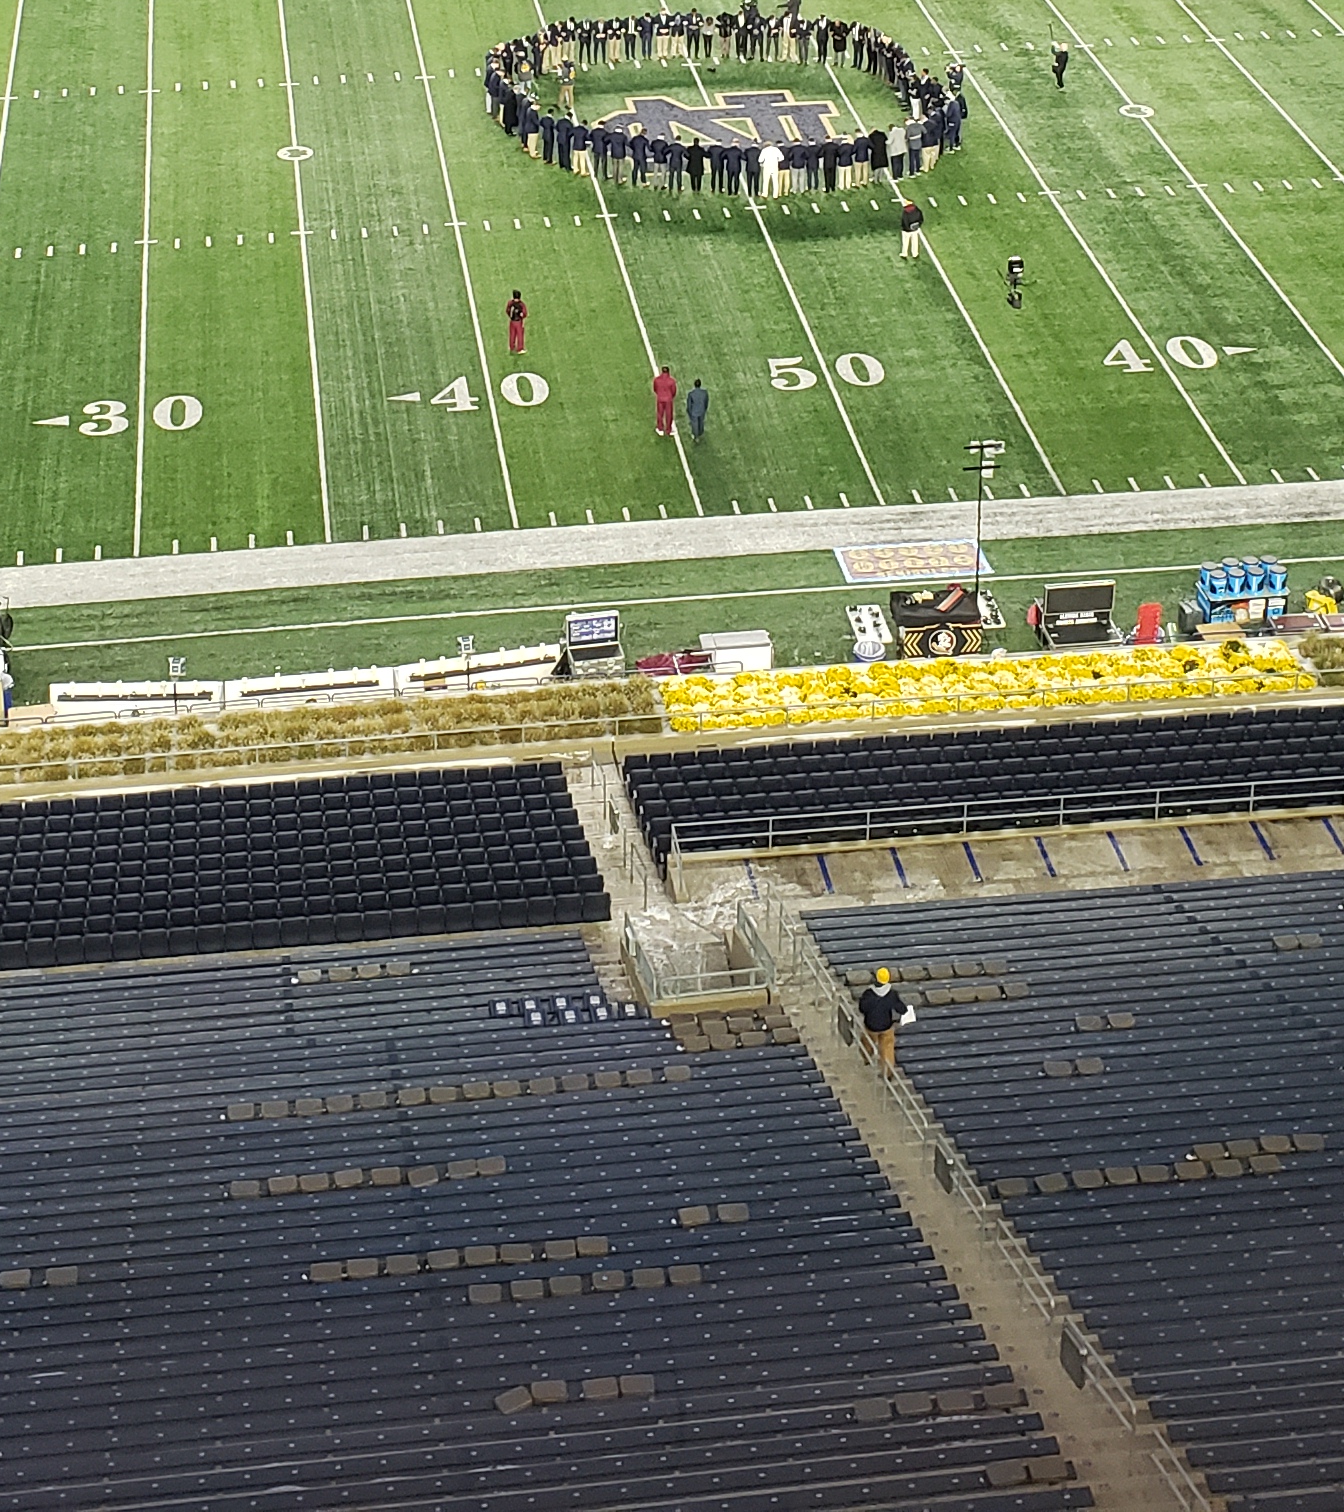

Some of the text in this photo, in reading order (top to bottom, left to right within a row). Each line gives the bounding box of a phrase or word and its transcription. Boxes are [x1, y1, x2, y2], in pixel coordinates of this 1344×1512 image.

[768, 352, 885, 390] 50
[1102, 335, 1218, 373] 40
[430, 372, 551, 412] 40
[77, 395, 203, 437] 30
